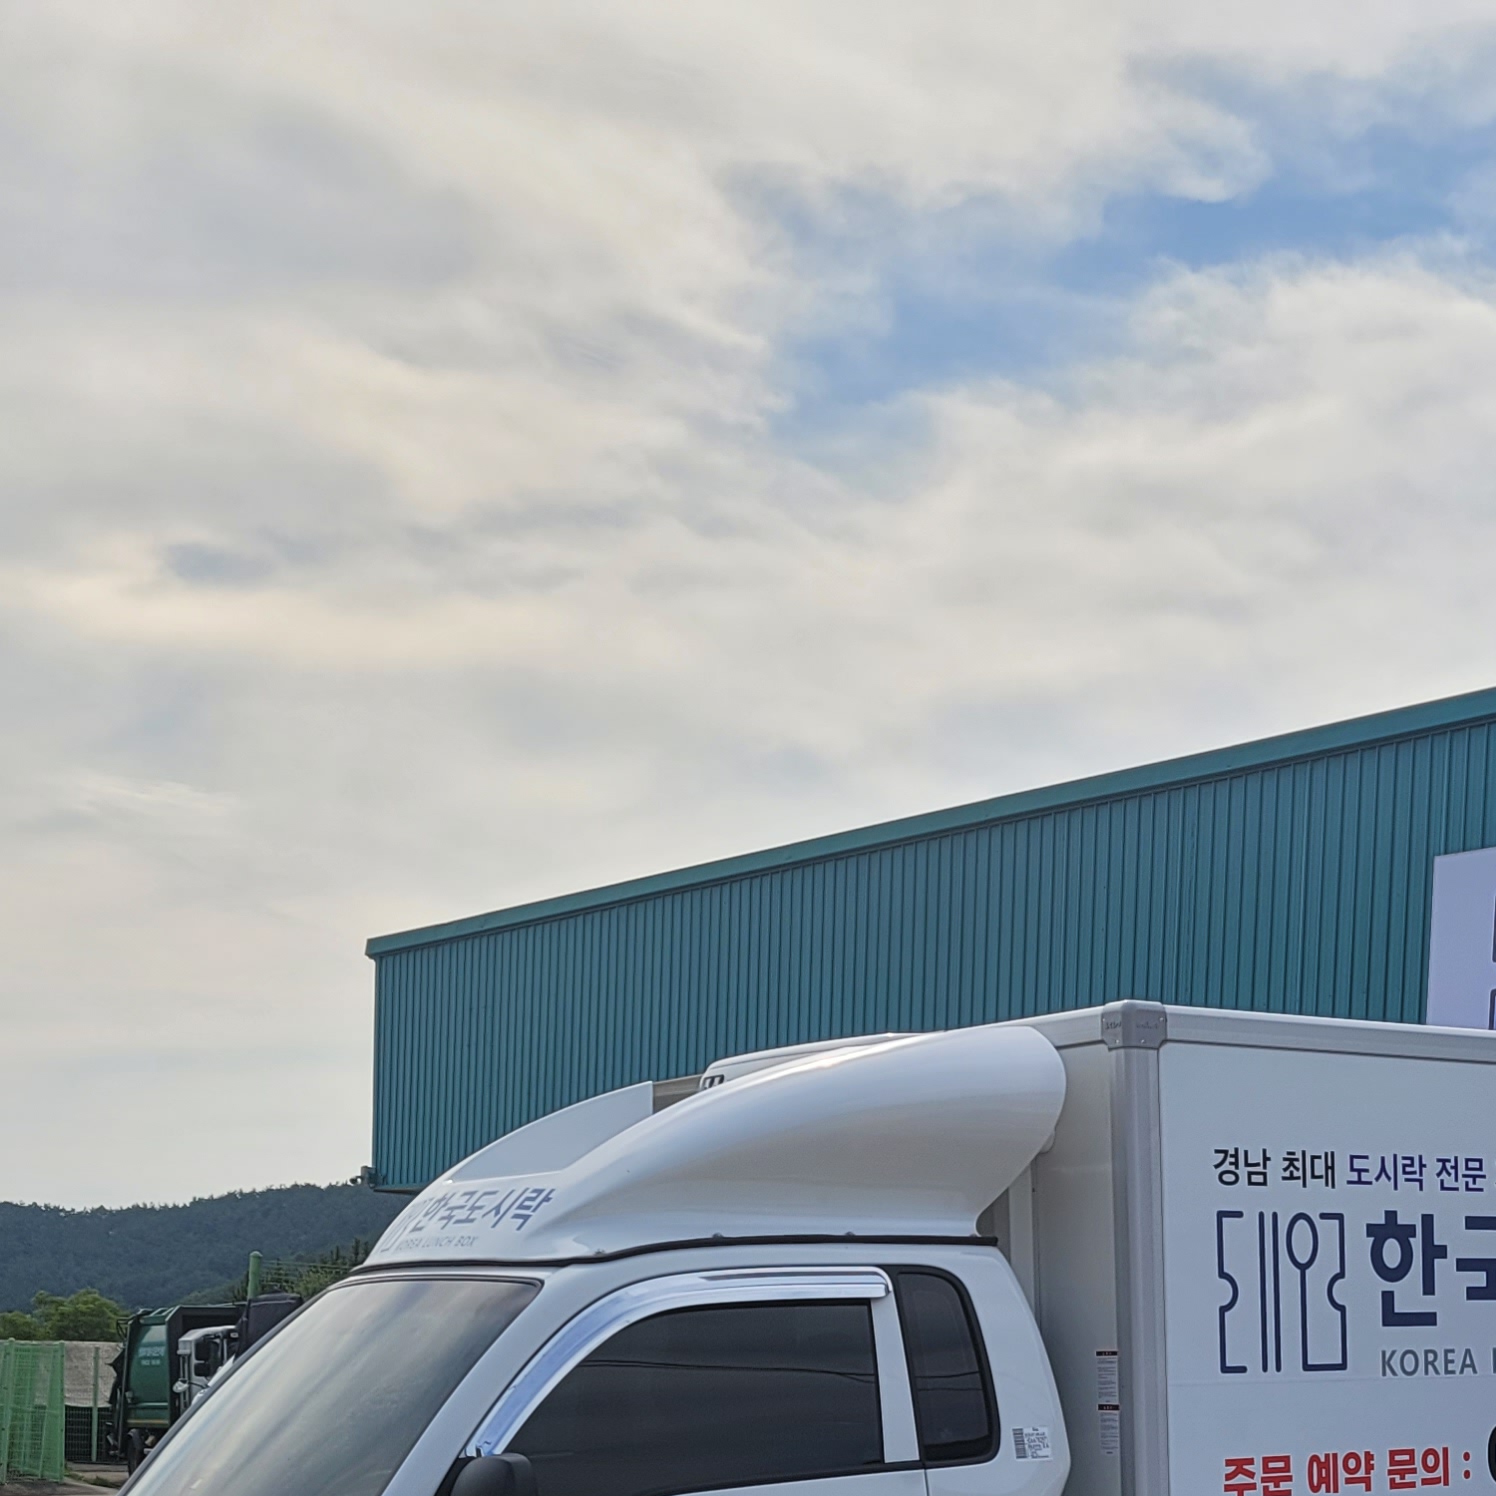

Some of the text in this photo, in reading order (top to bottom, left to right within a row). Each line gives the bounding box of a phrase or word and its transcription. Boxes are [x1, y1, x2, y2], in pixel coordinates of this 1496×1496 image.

[1212, 1146, 1272, 1187] 경남
[1281, 1149, 1336, 1190] 최대
[1346, 1153, 1427, 1192] 도시락
[1435, 1155, 1487, 1193] 전문
[409, 1187, 557, 1233] 한국도시락
[454, 1235, 479, 1248] BOX
[1380, 1347, 1479, 1377] KOREA
[1307, 1450, 1375, 1494] 예약
